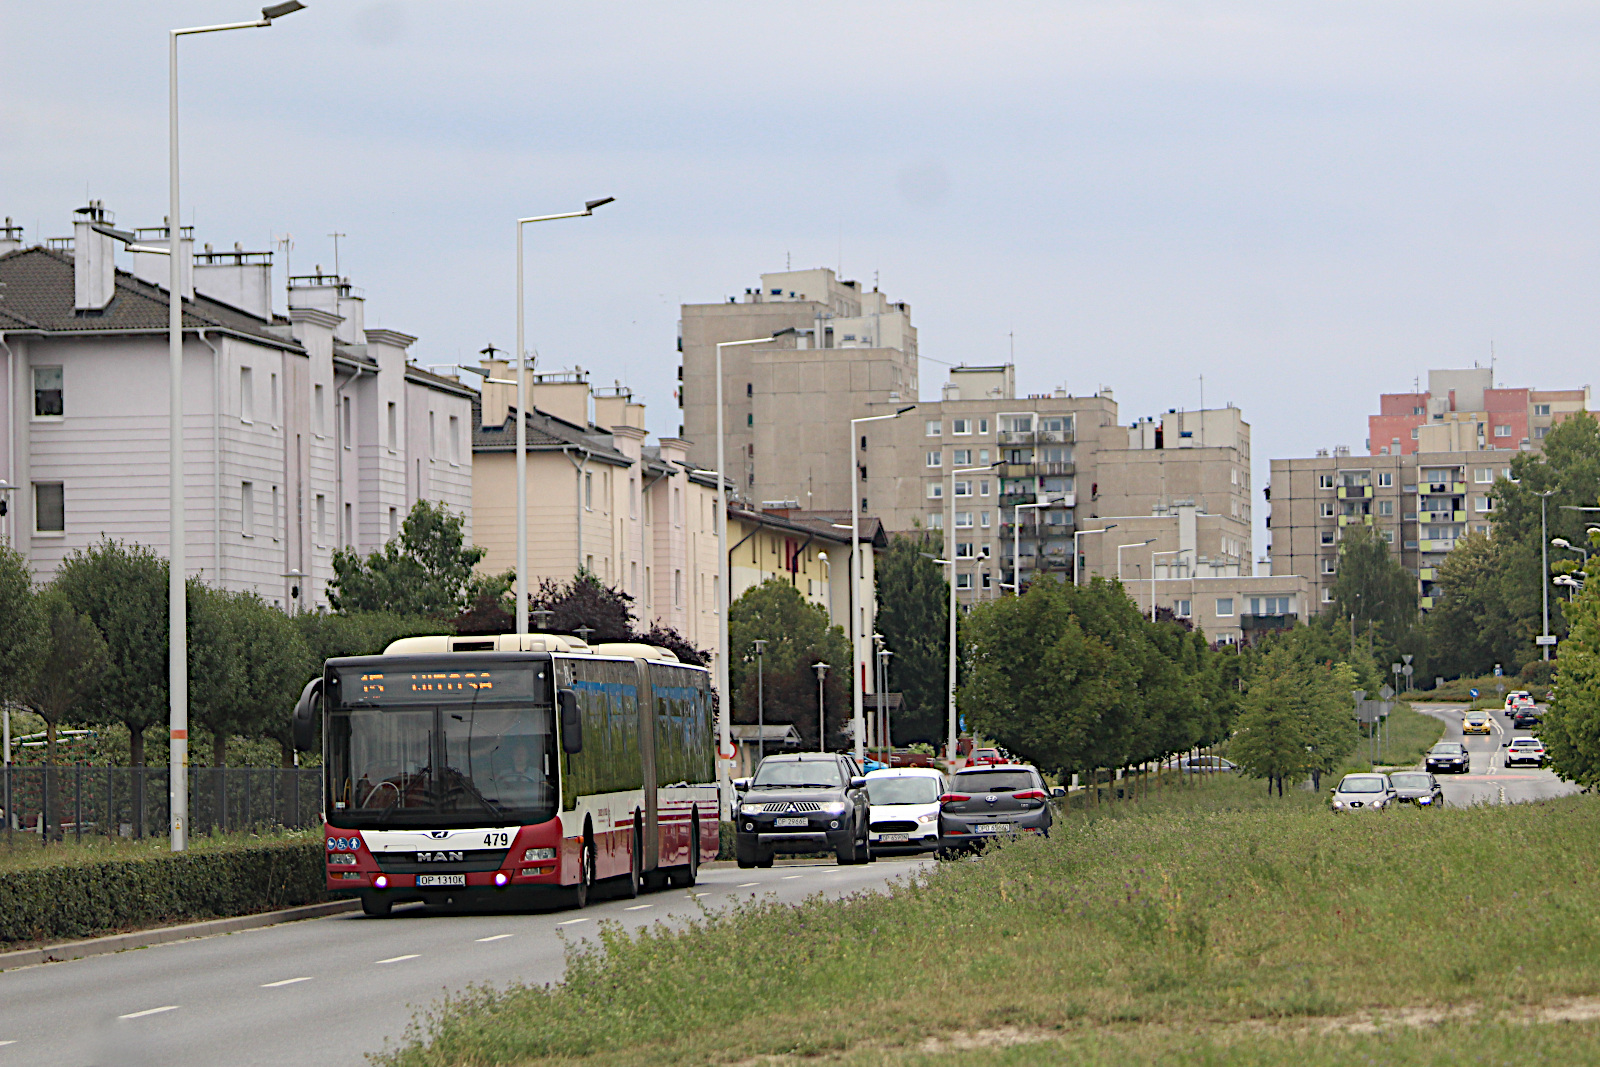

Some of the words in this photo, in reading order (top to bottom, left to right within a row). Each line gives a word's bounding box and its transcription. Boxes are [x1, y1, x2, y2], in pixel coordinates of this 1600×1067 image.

[483, 832, 508, 847] 479
[417, 851, 463, 862] MAN
[421, 876, 434, 885] OP
[437, 875, 463, 884] 1310K
